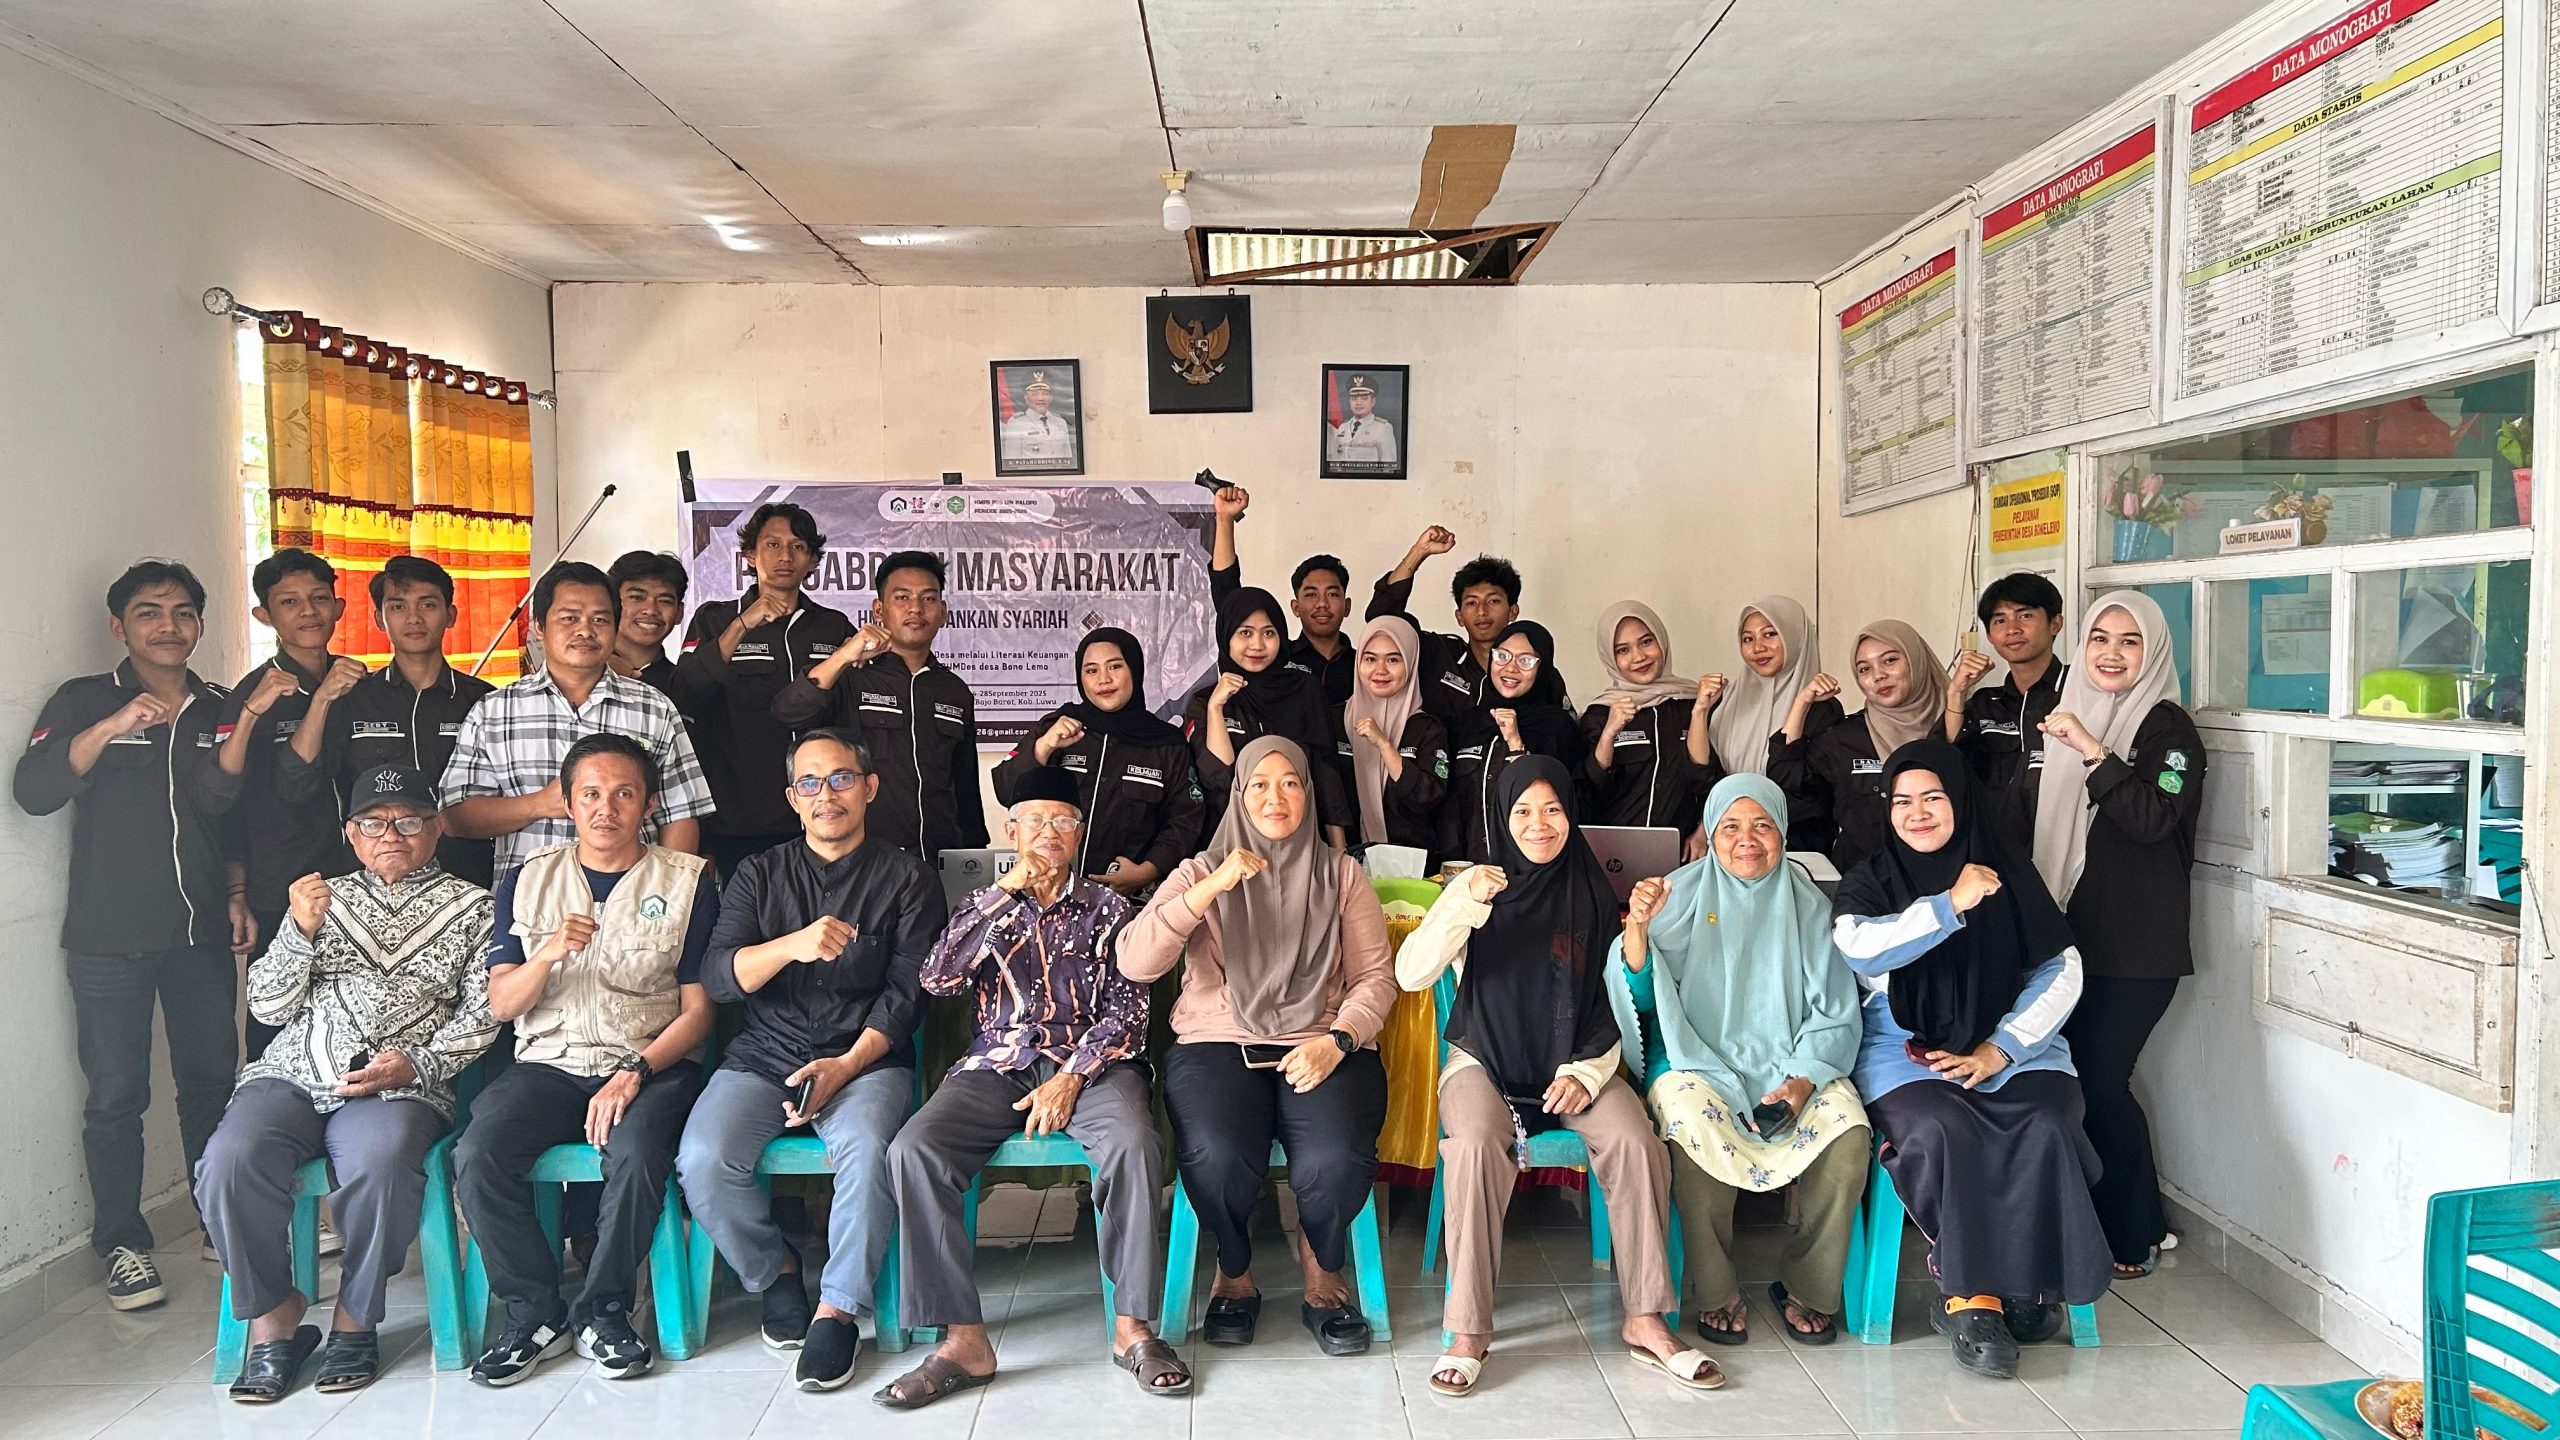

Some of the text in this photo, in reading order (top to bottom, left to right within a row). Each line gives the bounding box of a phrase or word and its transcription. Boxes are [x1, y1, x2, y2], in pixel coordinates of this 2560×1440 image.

[2272, 2, 2392, 82] DATA MONOGRAFI
[2293, 114, 2319, 133] DATA
[2321, 92, 2362, 119] STASTIS
[2022, 196, 2046, 217] DATA
[2048, 159, 2104, 199] MONOGRAFI
[2228, 253, 2252, 268] LUAS
[2255, 233, 2301, 258] WILAYAH
[2309, 200, 2388, 237] PERUNTUKAN
[2391, 181, 2435, 206] LAHAN
[1860, 261, 1934, 315] DATA MONOGRAFI
[2225, 528, 2292, 545] LOKET PELAYANAN
[956, 551, 1181, 592] MASYARAKAT
[1002, 609, 1068, 629] SYARIAH
[957, 650, 988, 659] melalui
[991, 650, 1025, 659] Literasi
[979, 662, 999, 671] desa
[1026, 662, 1048, 671] Lemo
[1029, 689, 1047, 697] 2025
[1607, 859, 1622, 873] hp
